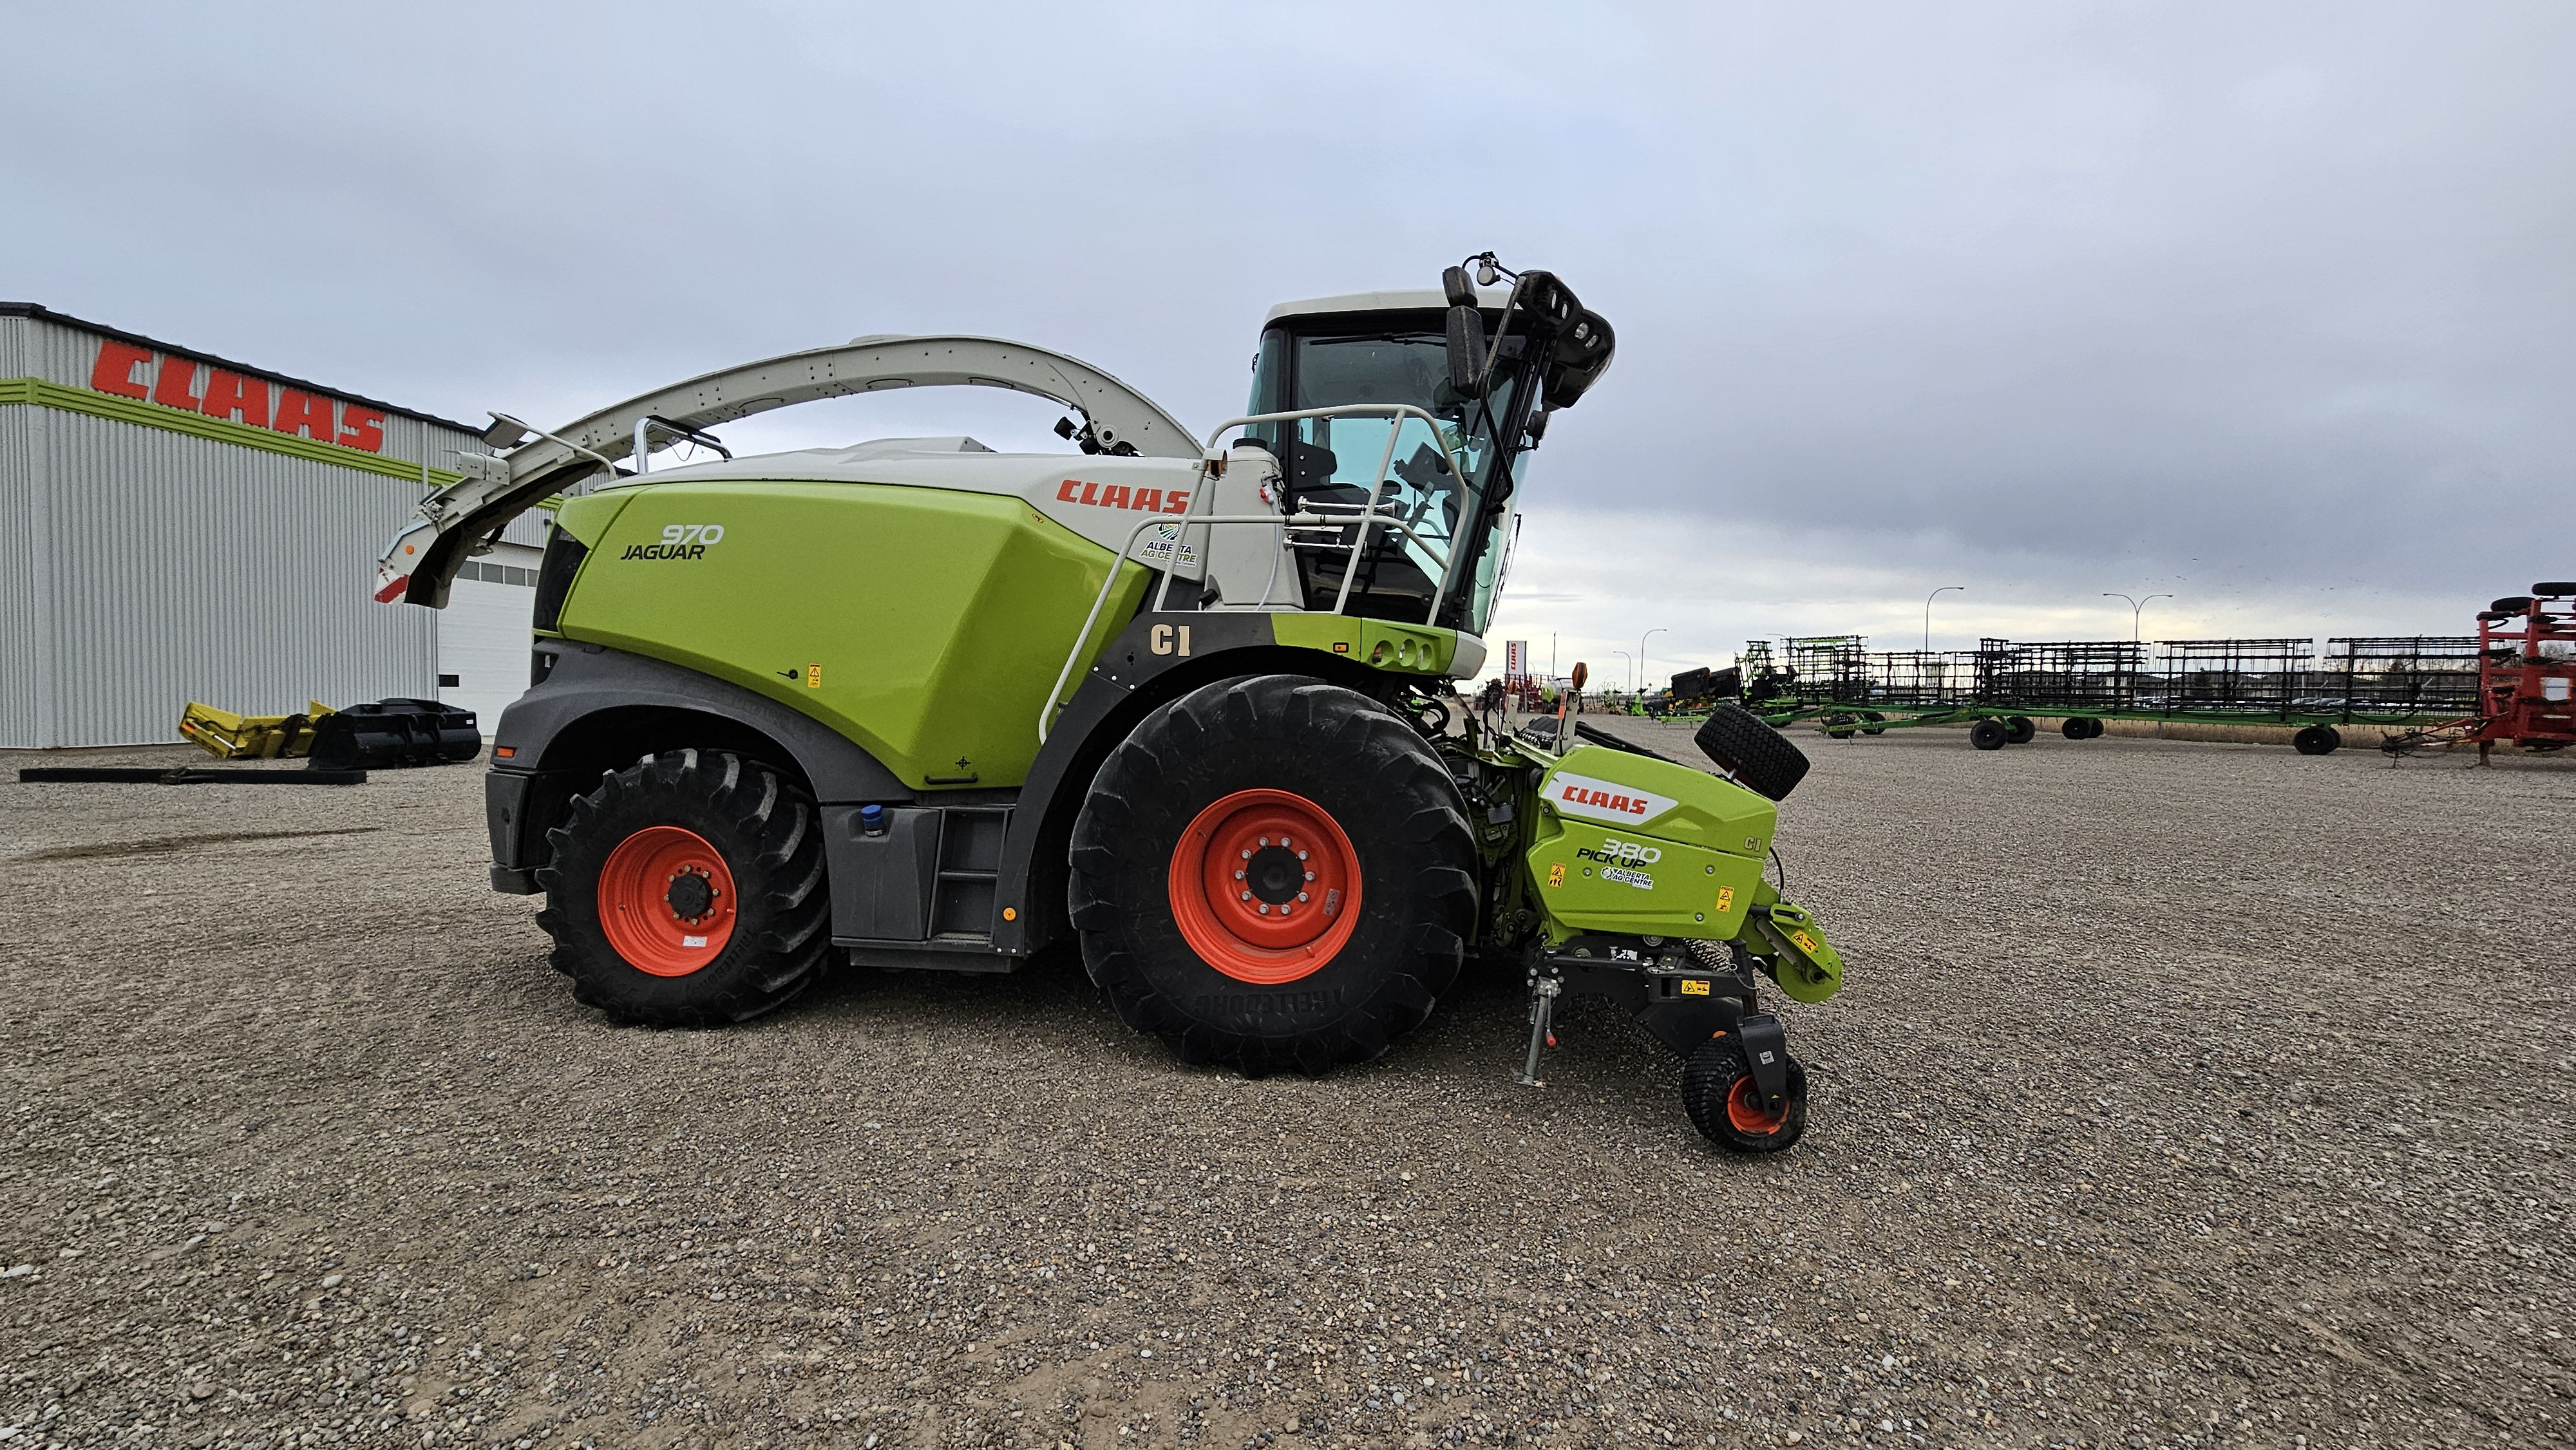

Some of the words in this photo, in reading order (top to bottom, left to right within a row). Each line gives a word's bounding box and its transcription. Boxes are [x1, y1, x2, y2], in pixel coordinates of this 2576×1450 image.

[91, 341, 385, 453] CLAAS
[1056, 480, 1190, 514] CLAAS
[661, 525, 724, 545] 970
[620, 545, 706, 560] JAGUAR
[1141, 549, 1155, 558] AG
[1157, 551, 1196, 563] CETRE
[1146, 541, 1191, 554] ALBETA
[1562, 786, 1648, 815] CLAAS
[1576, 848, 1618, 865] PICK
[1621, 857, 1647, 869] UP
[1600, 838, 1662, 863] 380
[1617, 869, 1649, 880] ALBERTA
[1624, 876, 1653, 886] CENTRE
